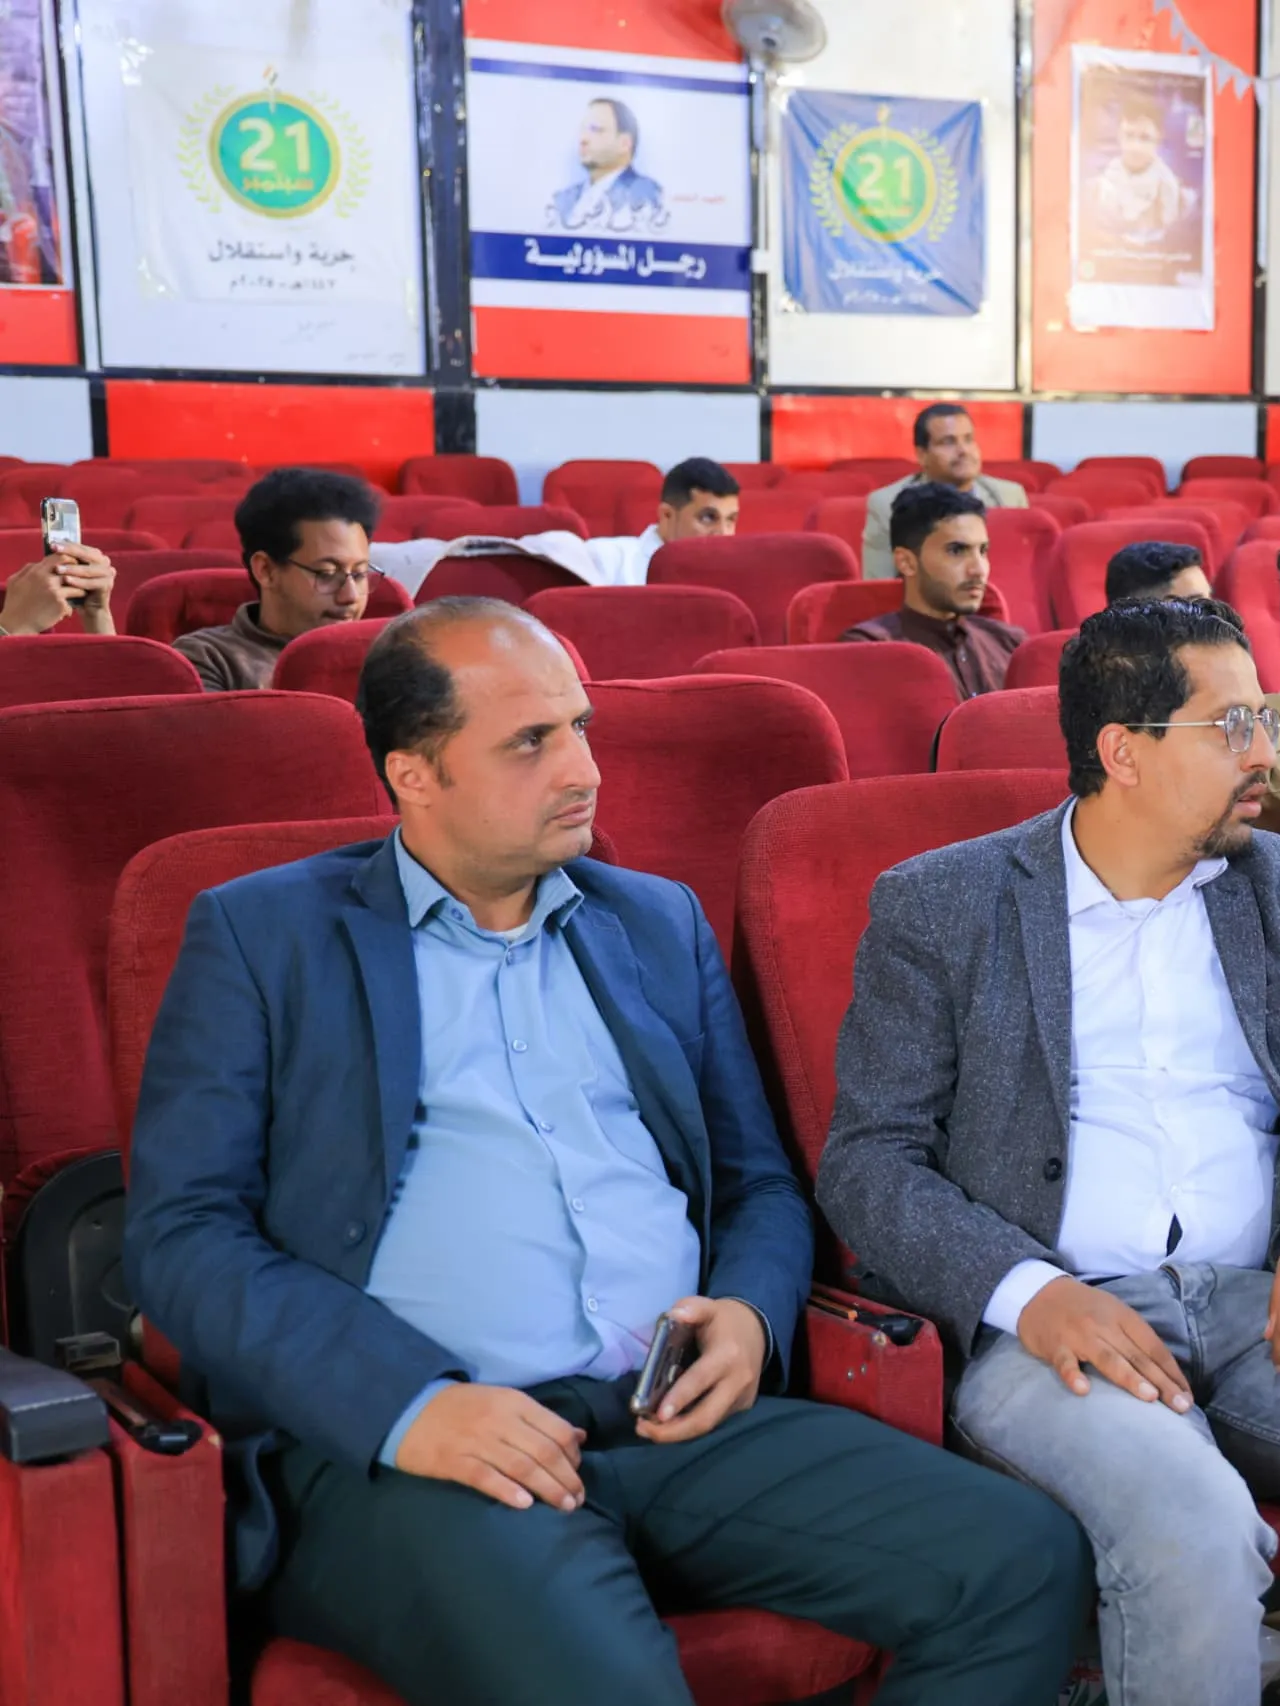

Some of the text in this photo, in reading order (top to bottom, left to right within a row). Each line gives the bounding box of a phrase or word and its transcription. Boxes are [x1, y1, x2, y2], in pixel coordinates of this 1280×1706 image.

[239, 117, 310, 172] 21
[857, 153, 911, 200] 21
[208, 238, 355, 267] حرية واستقلال
[524, 237, 707, 280] رجل المسؤولية
